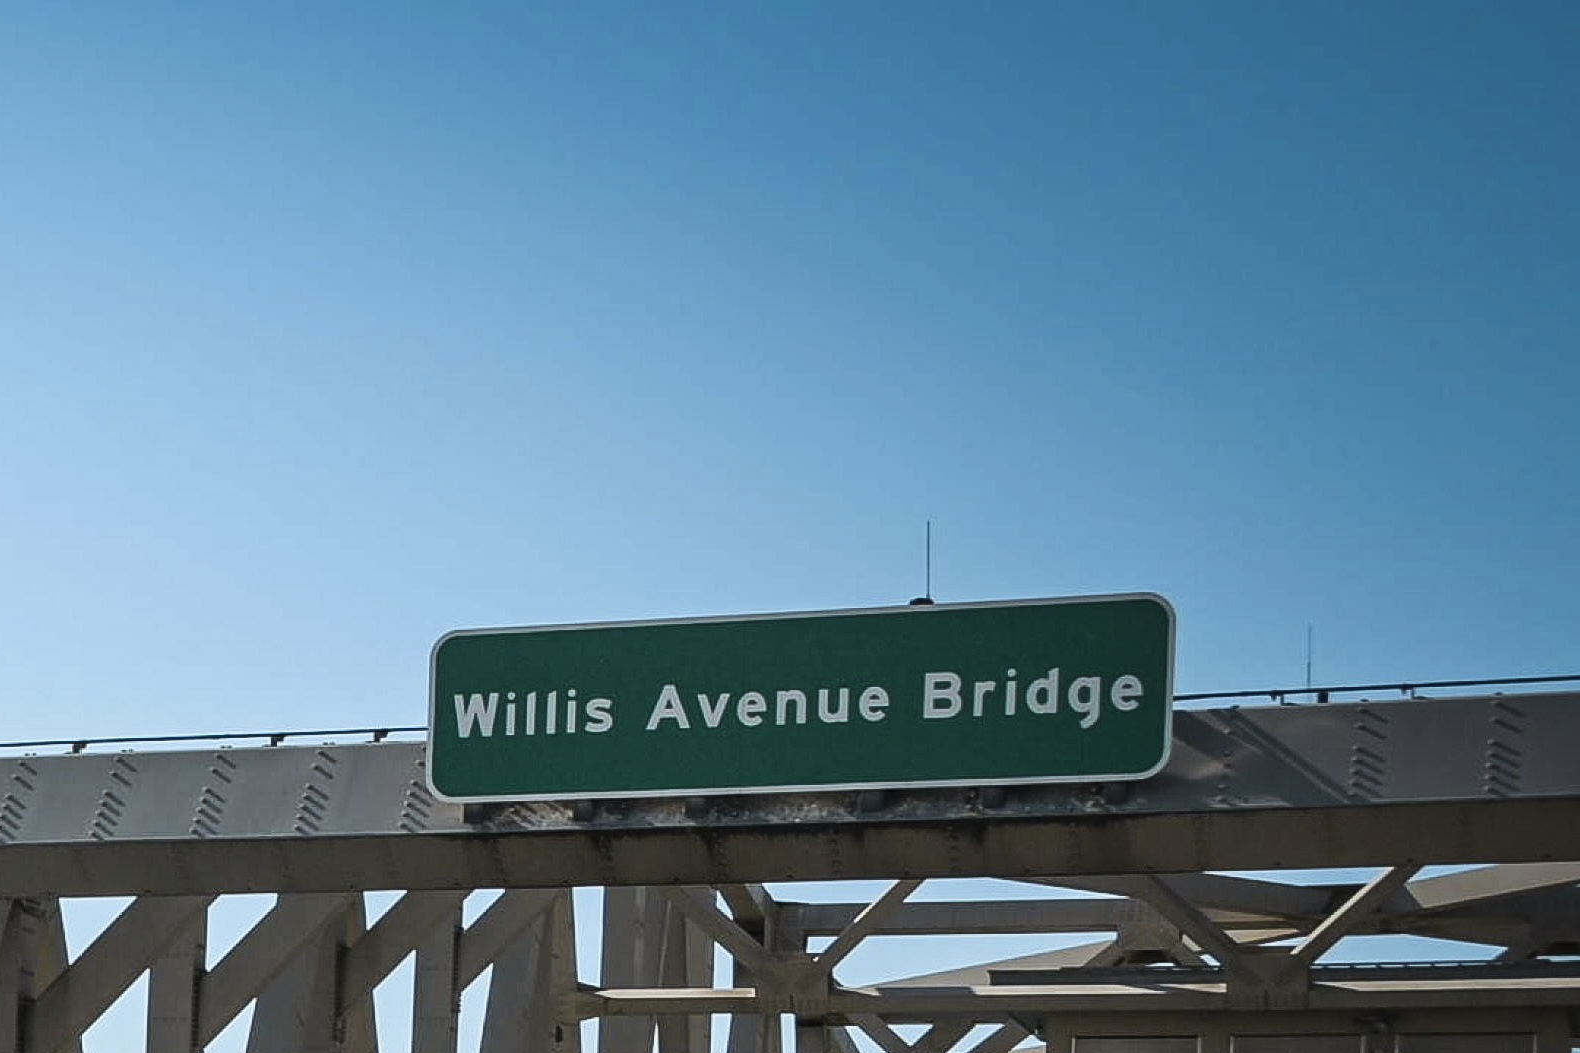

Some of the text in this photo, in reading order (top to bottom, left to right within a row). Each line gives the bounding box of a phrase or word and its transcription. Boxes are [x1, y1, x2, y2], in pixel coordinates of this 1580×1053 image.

[453, 667, 1144, 738] Willis Avenue Bridge
